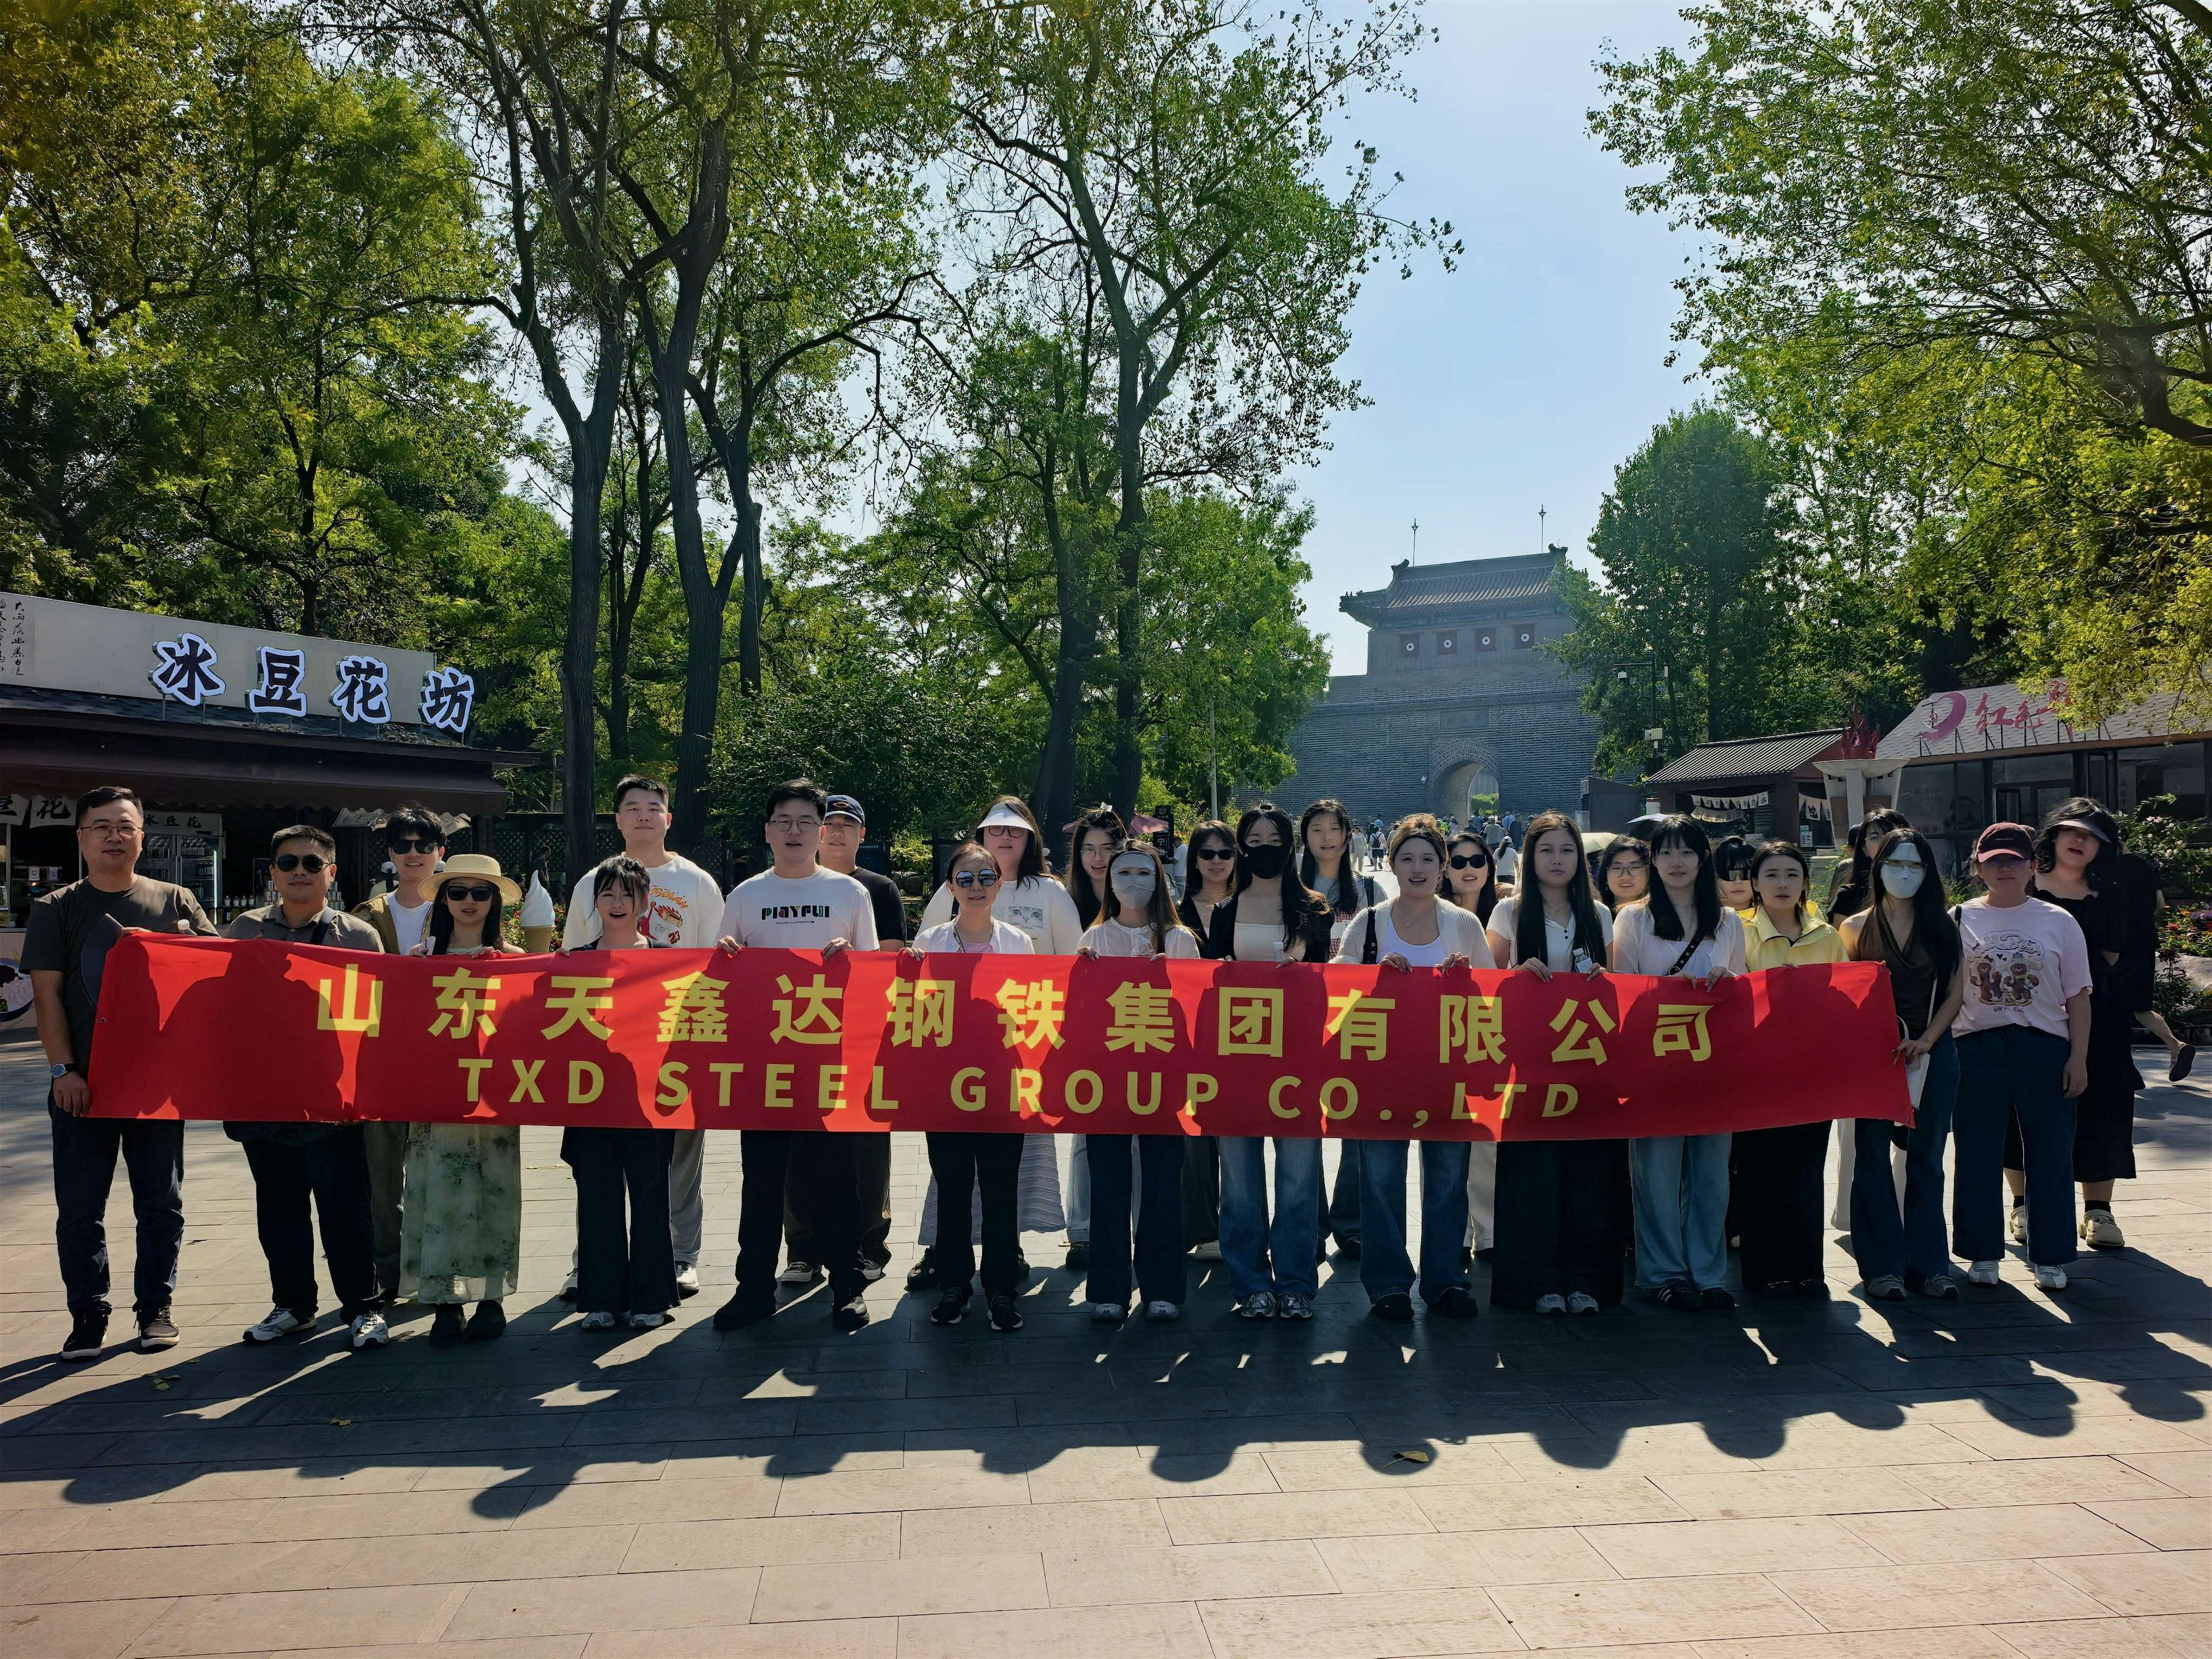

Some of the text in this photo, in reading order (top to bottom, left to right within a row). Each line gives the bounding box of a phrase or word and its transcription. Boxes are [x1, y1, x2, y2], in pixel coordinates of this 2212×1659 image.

[155, 633, 474, 732] 冰豆花坊
[318, 964, 1715, 1063] 山东天鑫达钢铁集团有限公司
[457, 1058, 604, 1104] TXD
[656, 1061, 899, 1110] STEEL
[951, 1068, 1219, 1116] GROUP
